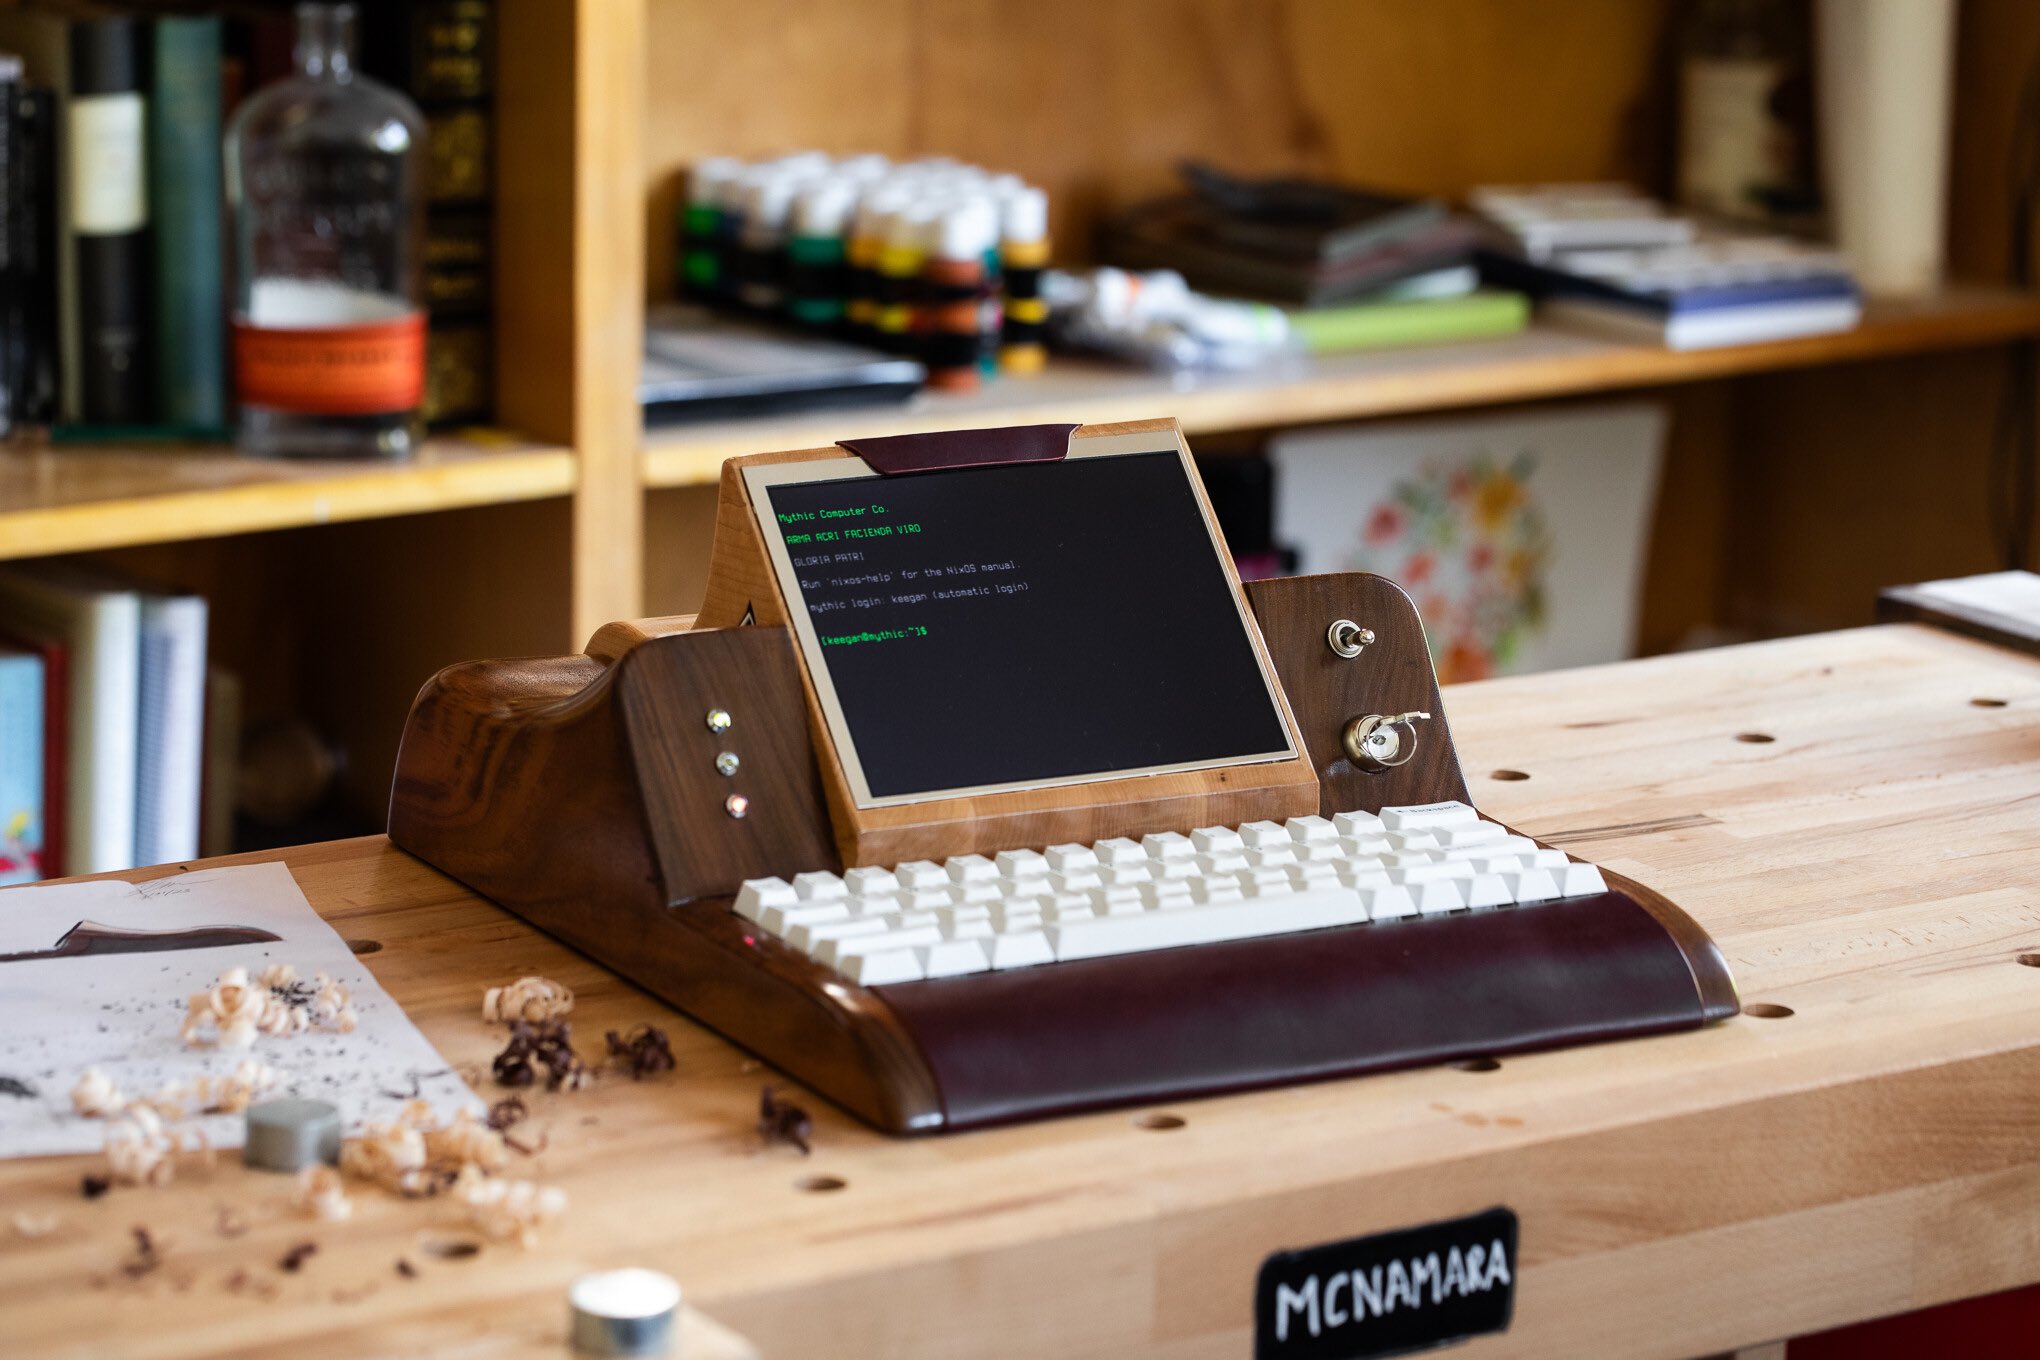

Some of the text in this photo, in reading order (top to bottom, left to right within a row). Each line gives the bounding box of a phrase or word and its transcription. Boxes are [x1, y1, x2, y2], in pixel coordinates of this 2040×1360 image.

[778, 505, 889, 524] Mythic Computer Co.
[786, 523, 922, 545] ARMA ACRI FACIENDA VIRO
[793, 552, 865, 567] GLORIA PATRI
[801, 579, 822, 590] Run
[901, 571, 919, 580] for
[924, 567, 943, 578] the
[947, 564, 977, 575] NixOS
[981, 560, 1021, 572] manual.
[810, 582, 1029, 614] mythic login: keegan (automatic login)
[1275, 1238, 1511, 1342] MCNAMARA
